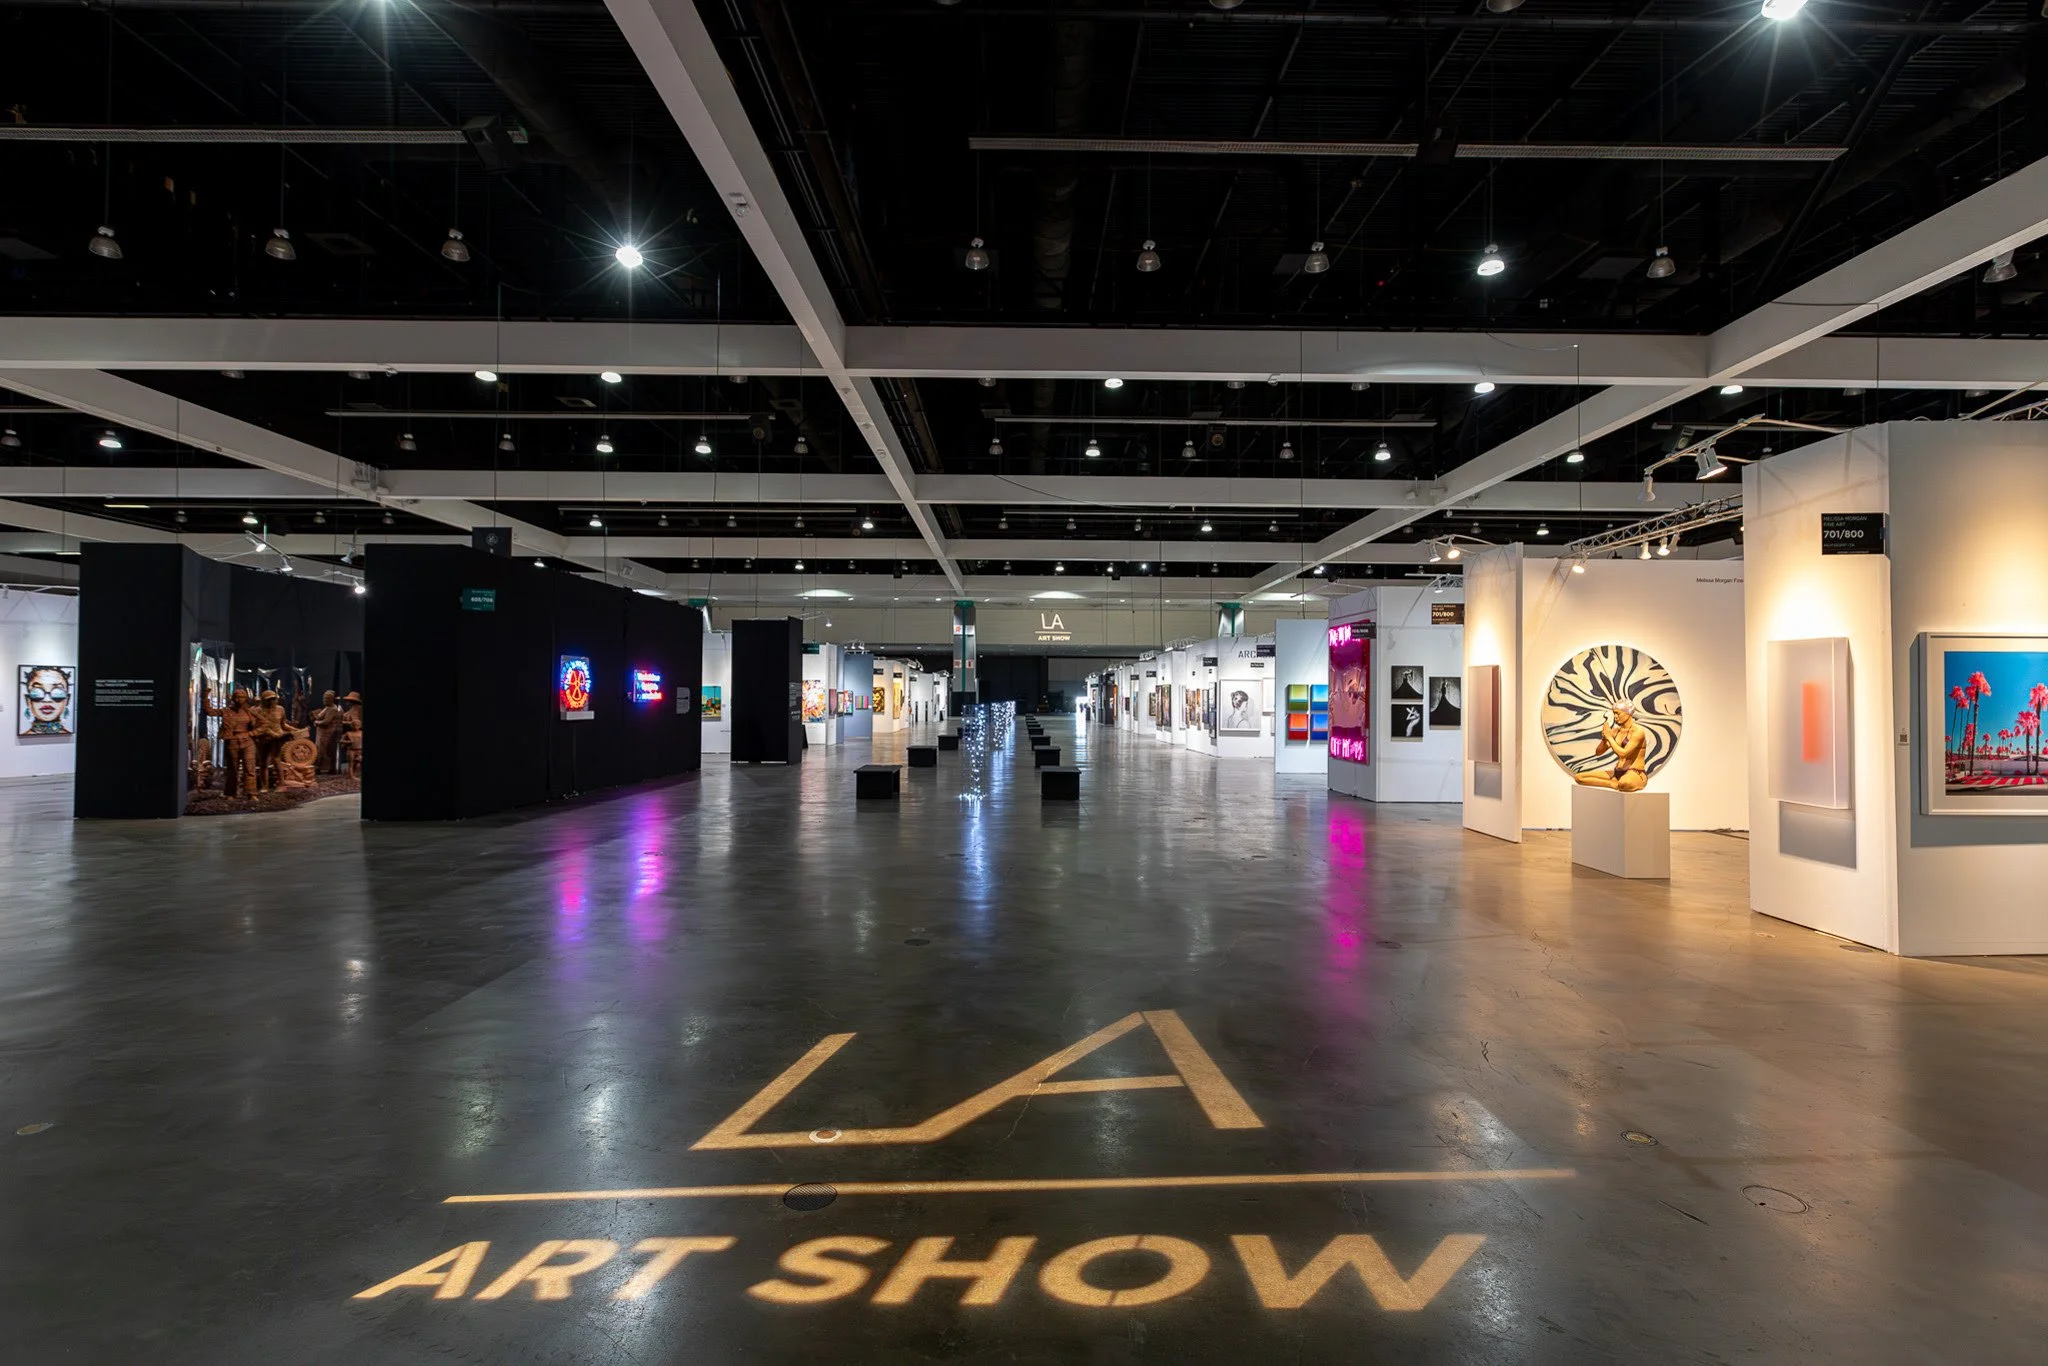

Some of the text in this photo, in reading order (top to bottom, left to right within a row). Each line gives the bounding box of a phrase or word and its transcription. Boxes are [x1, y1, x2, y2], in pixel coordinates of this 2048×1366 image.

[1823, 529, 1865, 540] 701/800
[1041, 612, 1065, 630] LA
[690, 1009, 1265, 1152] LA
[353, 1233, 1487, 1312] ART SHOW
